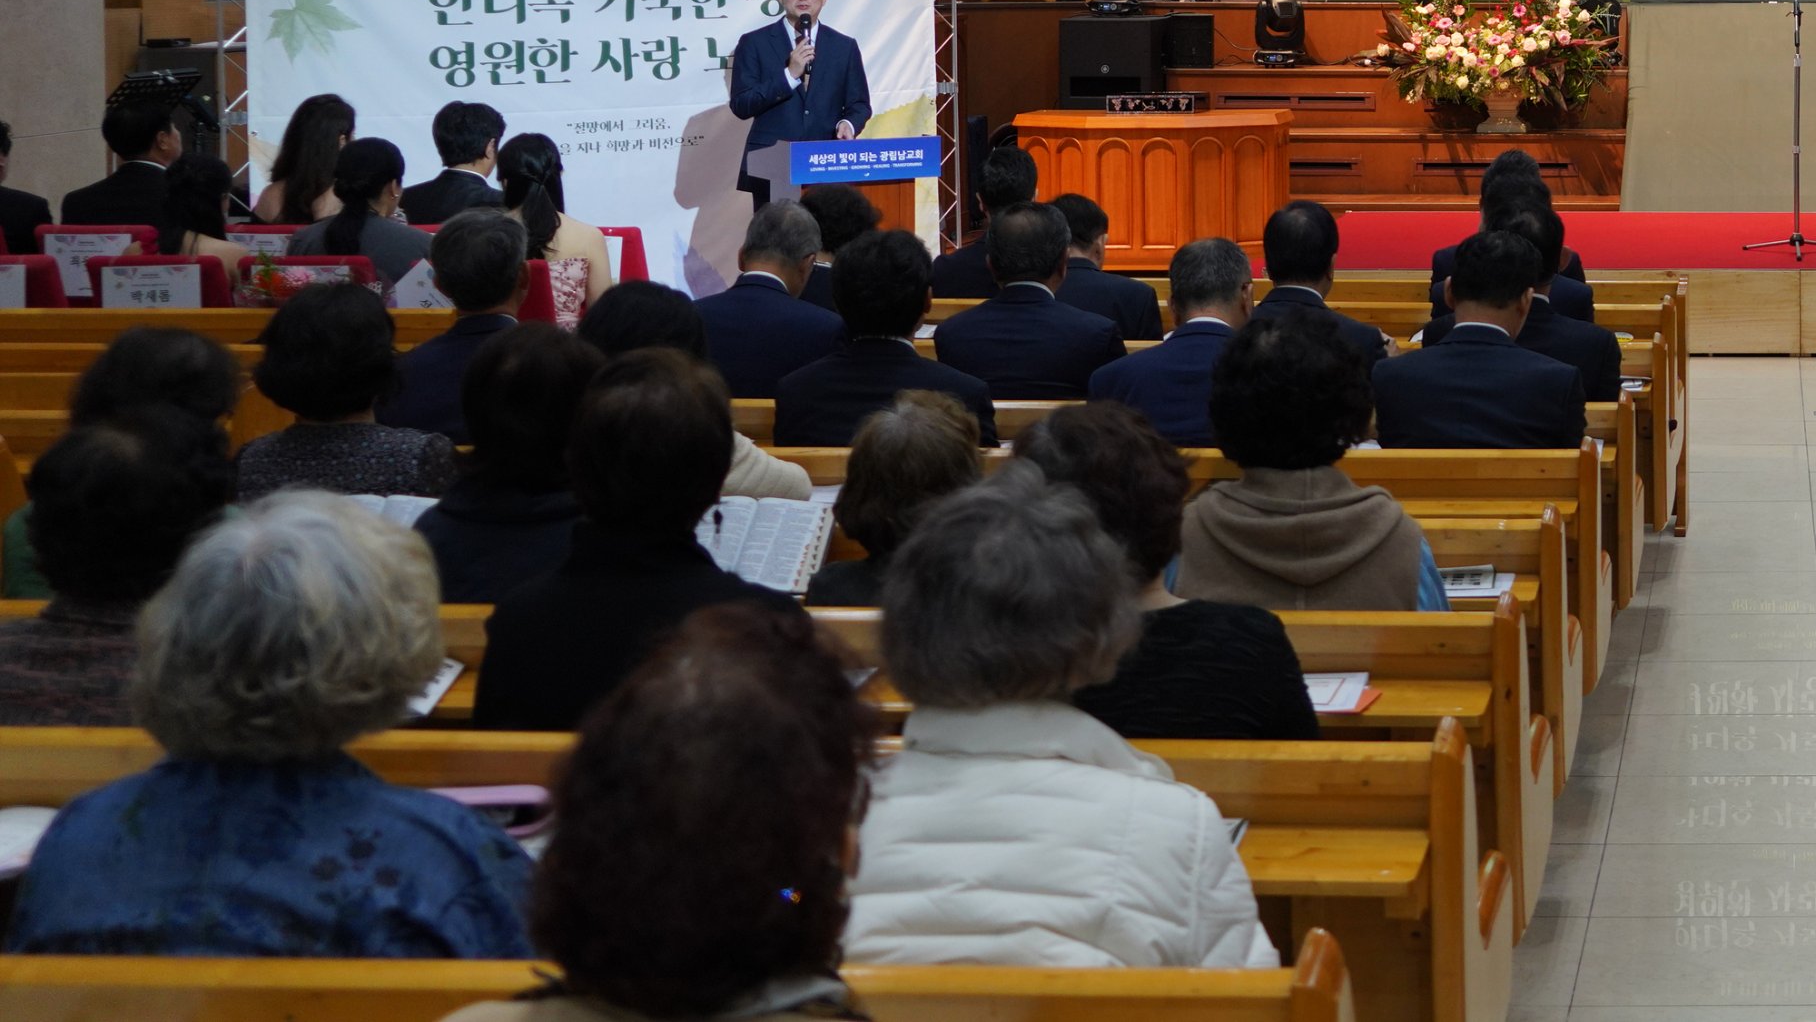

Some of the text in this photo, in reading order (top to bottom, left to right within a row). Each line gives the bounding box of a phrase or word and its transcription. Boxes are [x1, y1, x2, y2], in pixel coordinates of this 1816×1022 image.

[428, 38, 579, 88] 영원한
[591, 36, 688, 82] 사랑
[577, 141, 601, 154] 지나
[606, 139, 645, 153] 희망과
[809, 149, 924, 165] 세상의 빛이 되는 광림남교회
